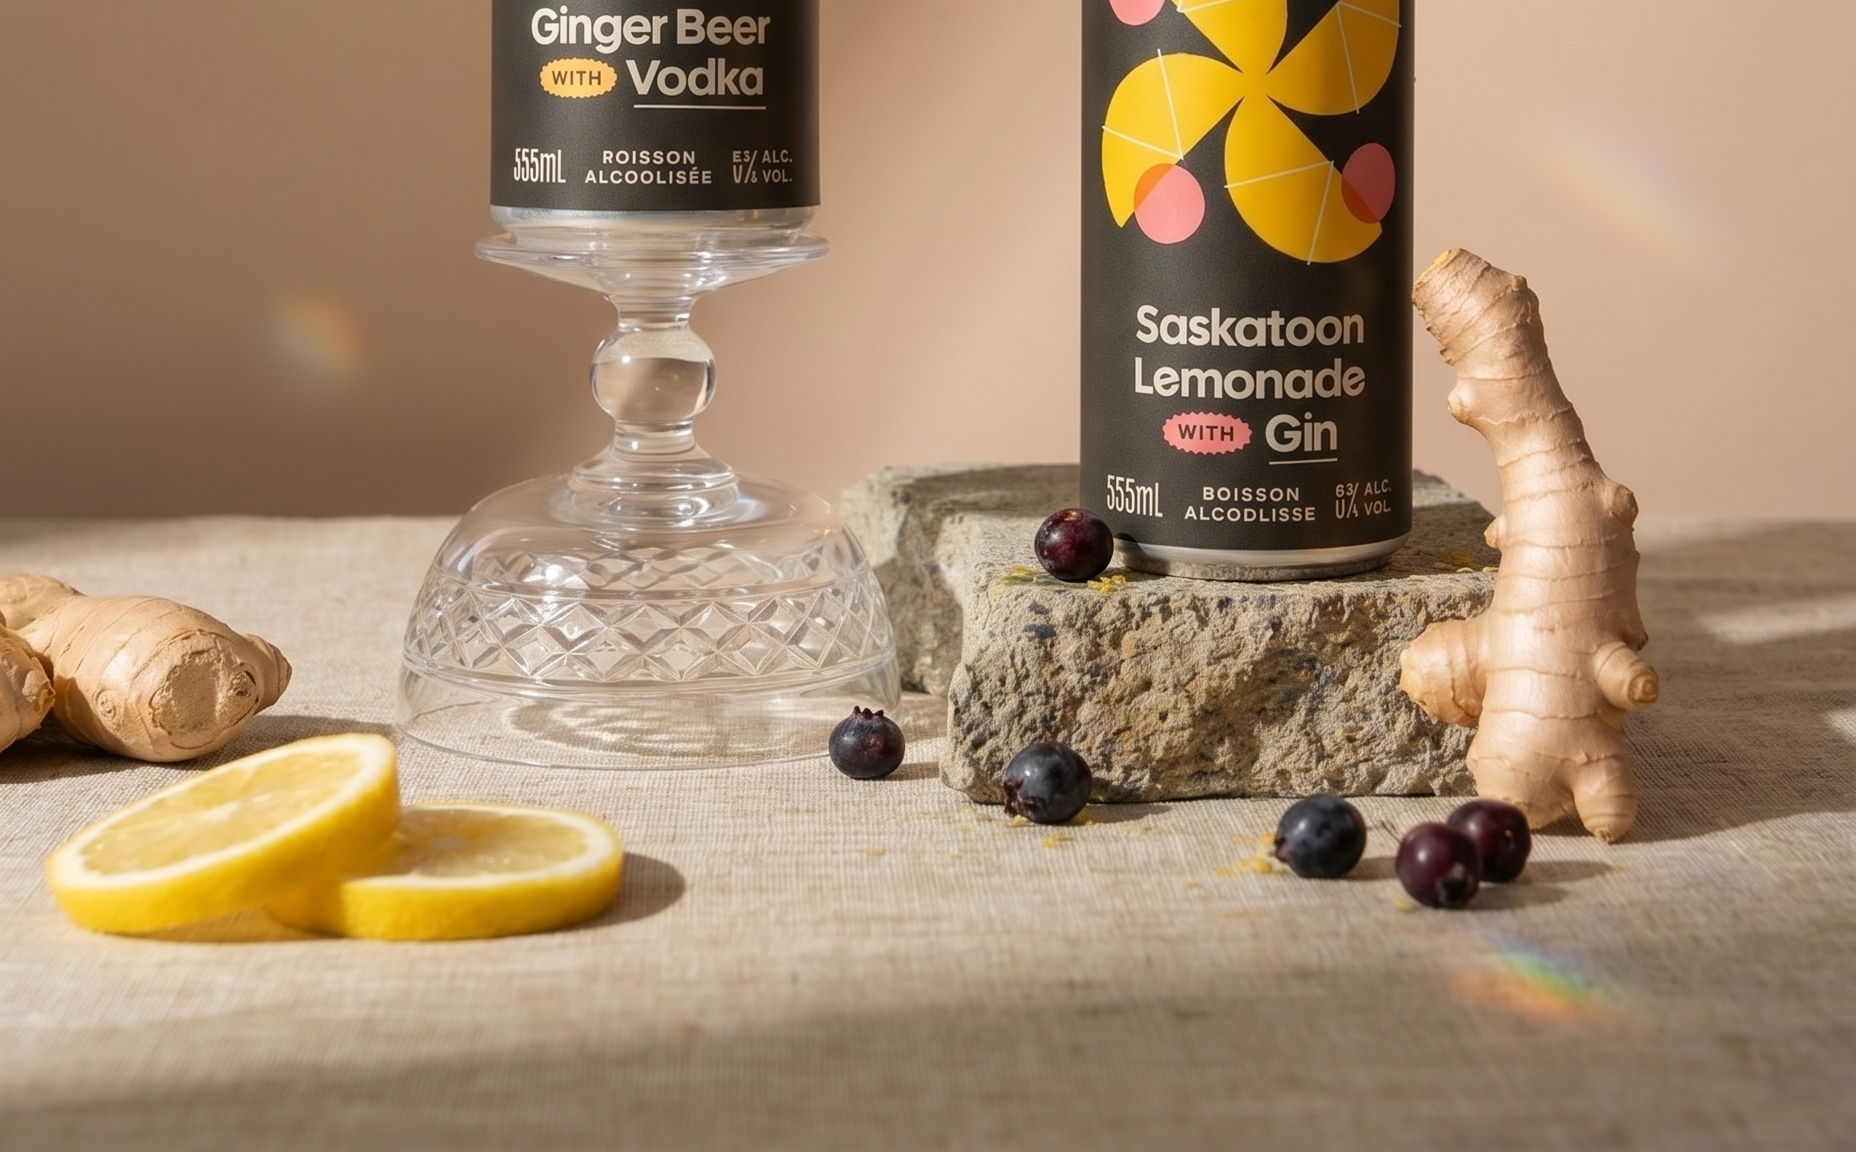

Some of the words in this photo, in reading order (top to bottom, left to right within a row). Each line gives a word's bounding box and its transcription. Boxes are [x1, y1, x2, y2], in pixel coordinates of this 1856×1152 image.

[531, 5, 668, 54] Ginger
[676, 8, 771, 45] Beer
[552, 70, 602, 86] WITH
[625, 57, 763, 96] Vodka
[513, 147, 566, 183] 555mL
[603, 150, 695, 164] ROISSON
[762, 149, 793, 164] ALC.
[585, 167, 712, 184] ALCOOLISÉE
[762, 169, 793, 183] VOL.
[1136, 304, 1365, 347] Saskatoon
[1134, 357, 1366, 399] Lemonade
[1178, 423, 1234, 441] WITH
[1265, 411, 1338, 453] Gin
[1106, 474, 1163, 518] 555mL
[1202, 486, 1300, 502] BOISSON
